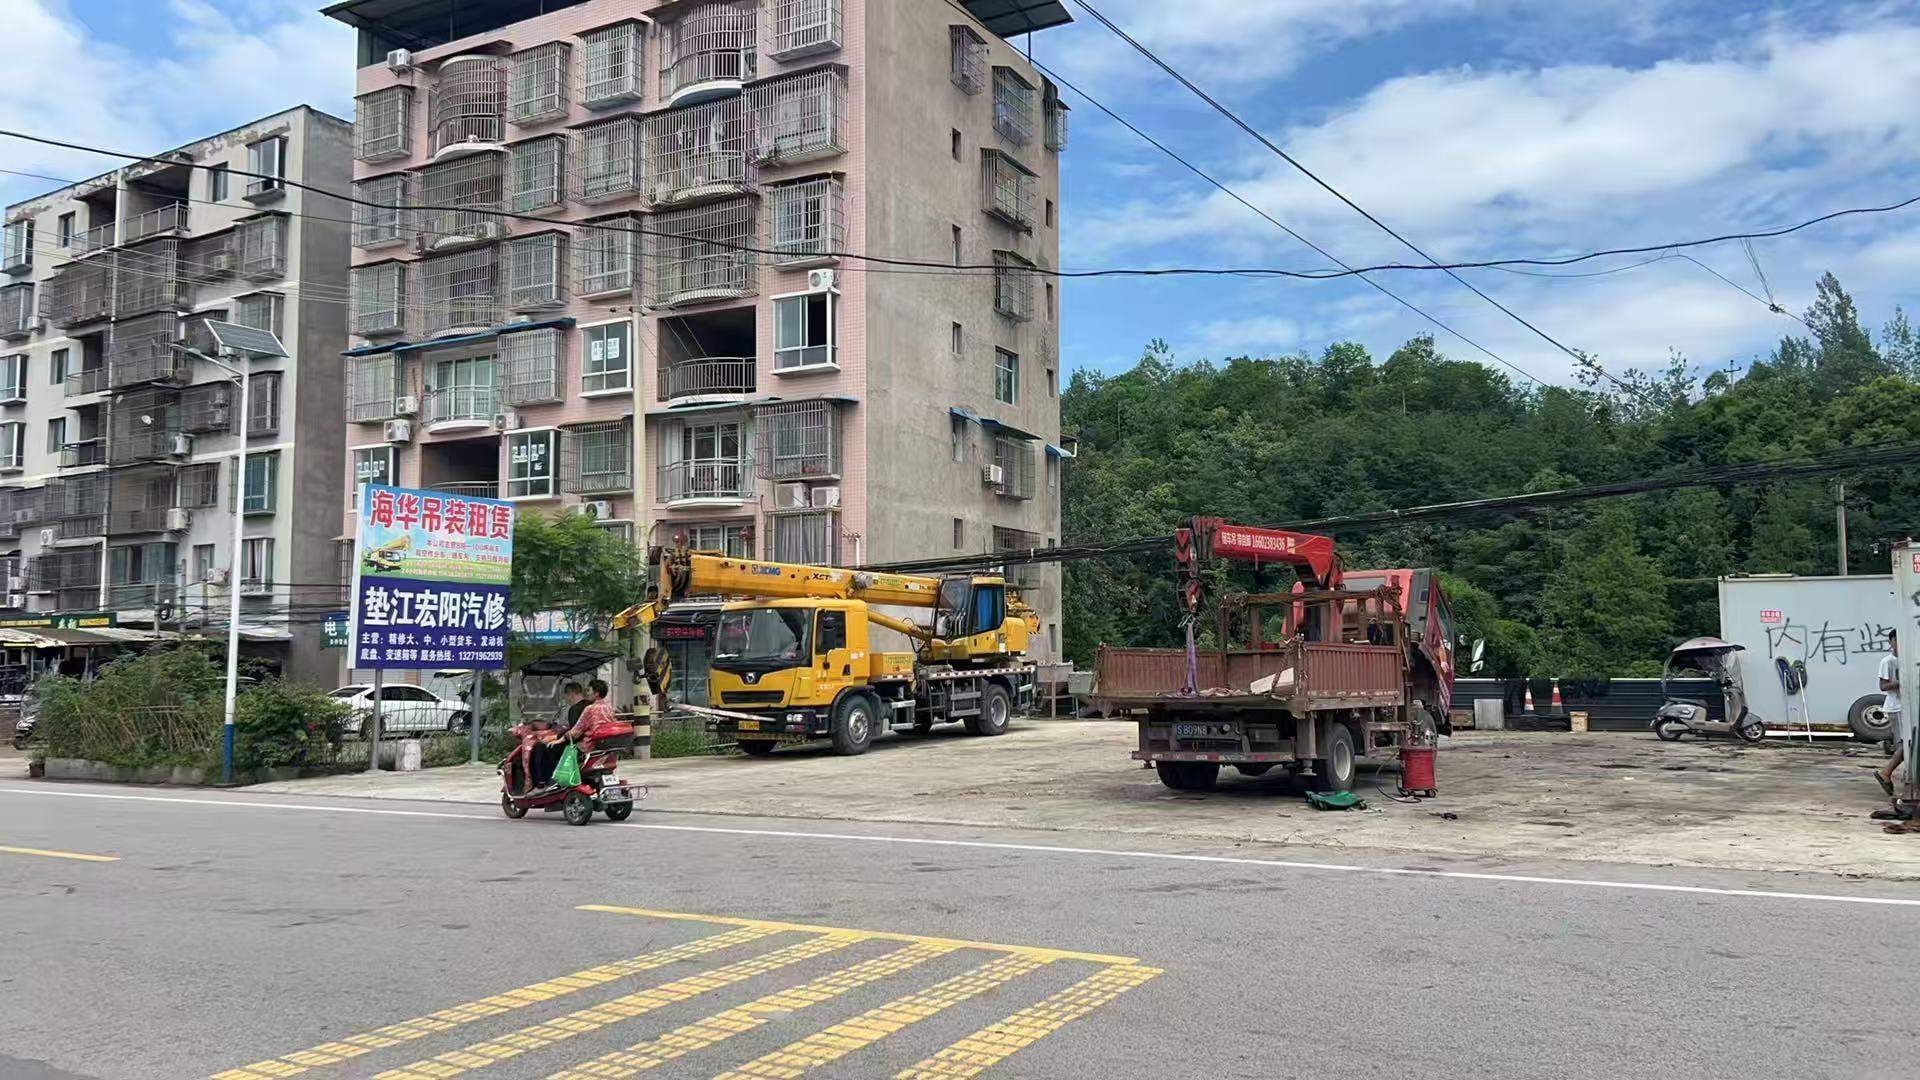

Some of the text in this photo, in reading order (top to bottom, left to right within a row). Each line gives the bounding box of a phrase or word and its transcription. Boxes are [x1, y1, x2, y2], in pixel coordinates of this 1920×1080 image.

[370, 489, 511, 540] 海华吊装租赁
[364, 586, 506, 630] 垫江宏阳汽修
